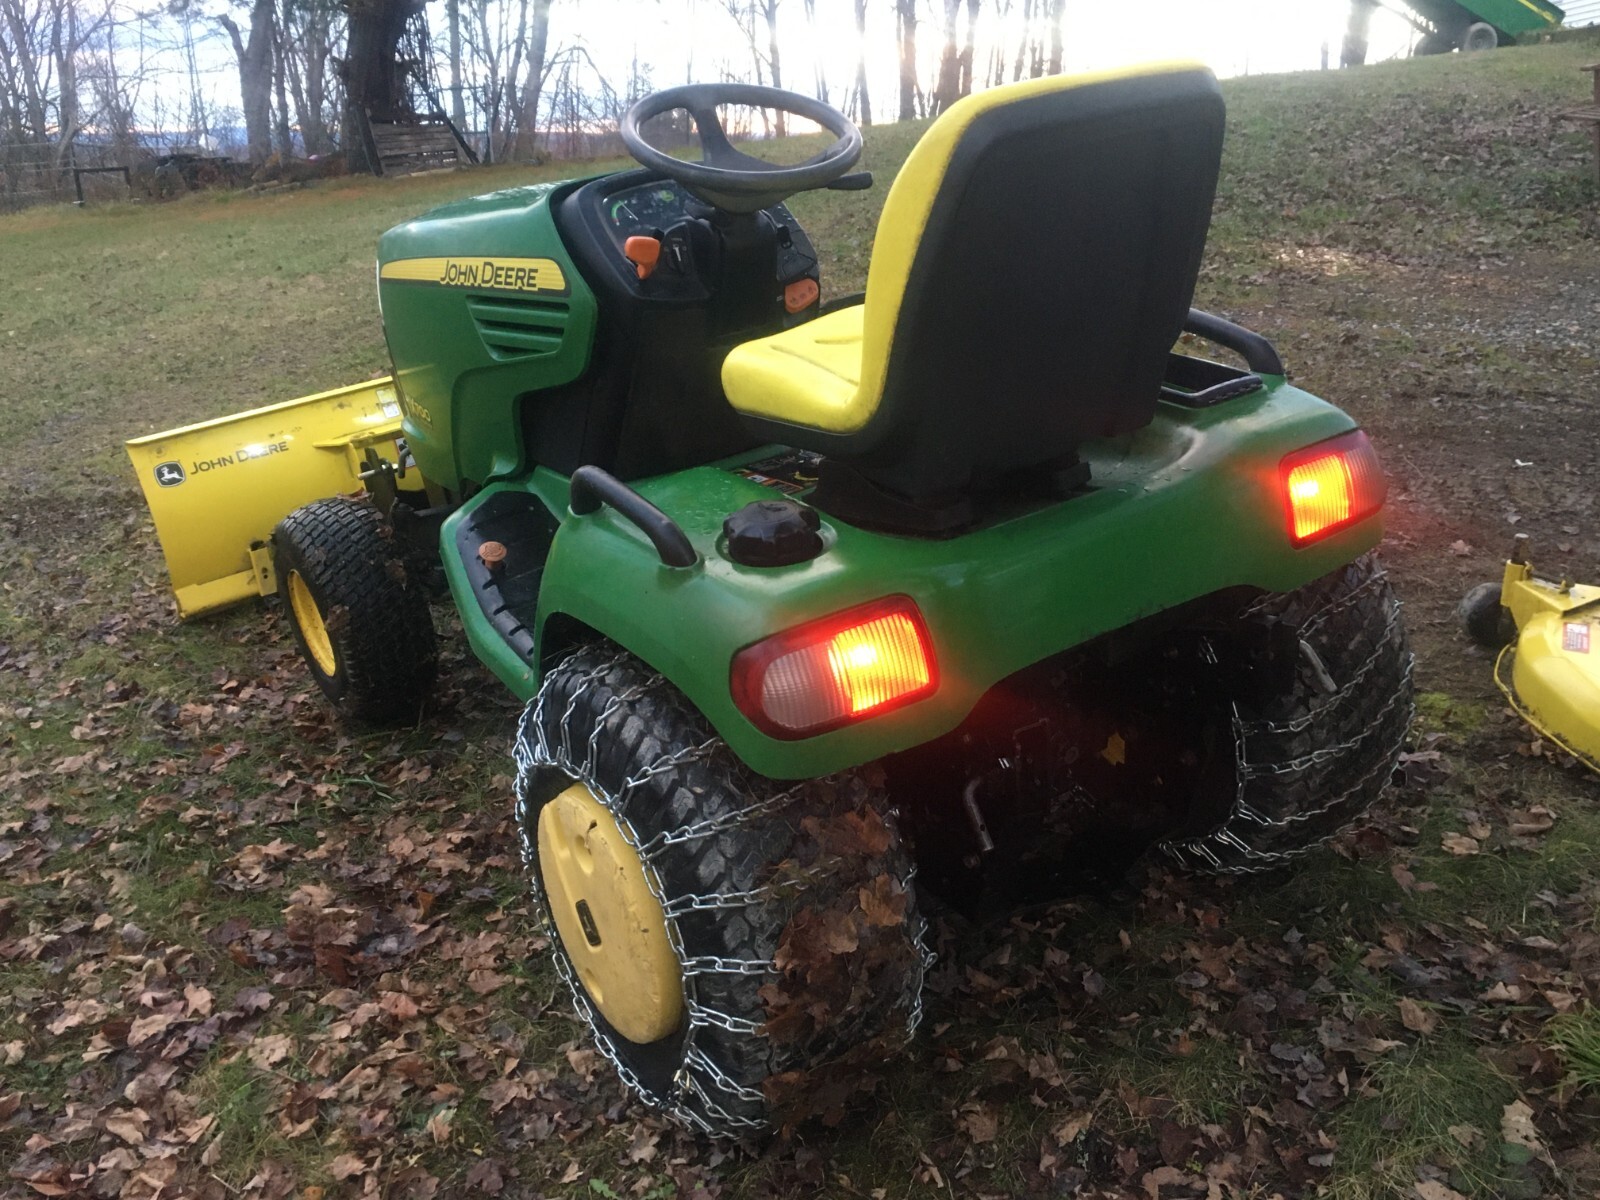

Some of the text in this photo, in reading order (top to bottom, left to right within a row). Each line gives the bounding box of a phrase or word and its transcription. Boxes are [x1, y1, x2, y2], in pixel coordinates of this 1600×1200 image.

[440, 259, 539, 289] JOHN DEERE
[190, 455, 234, 475] JOHN
